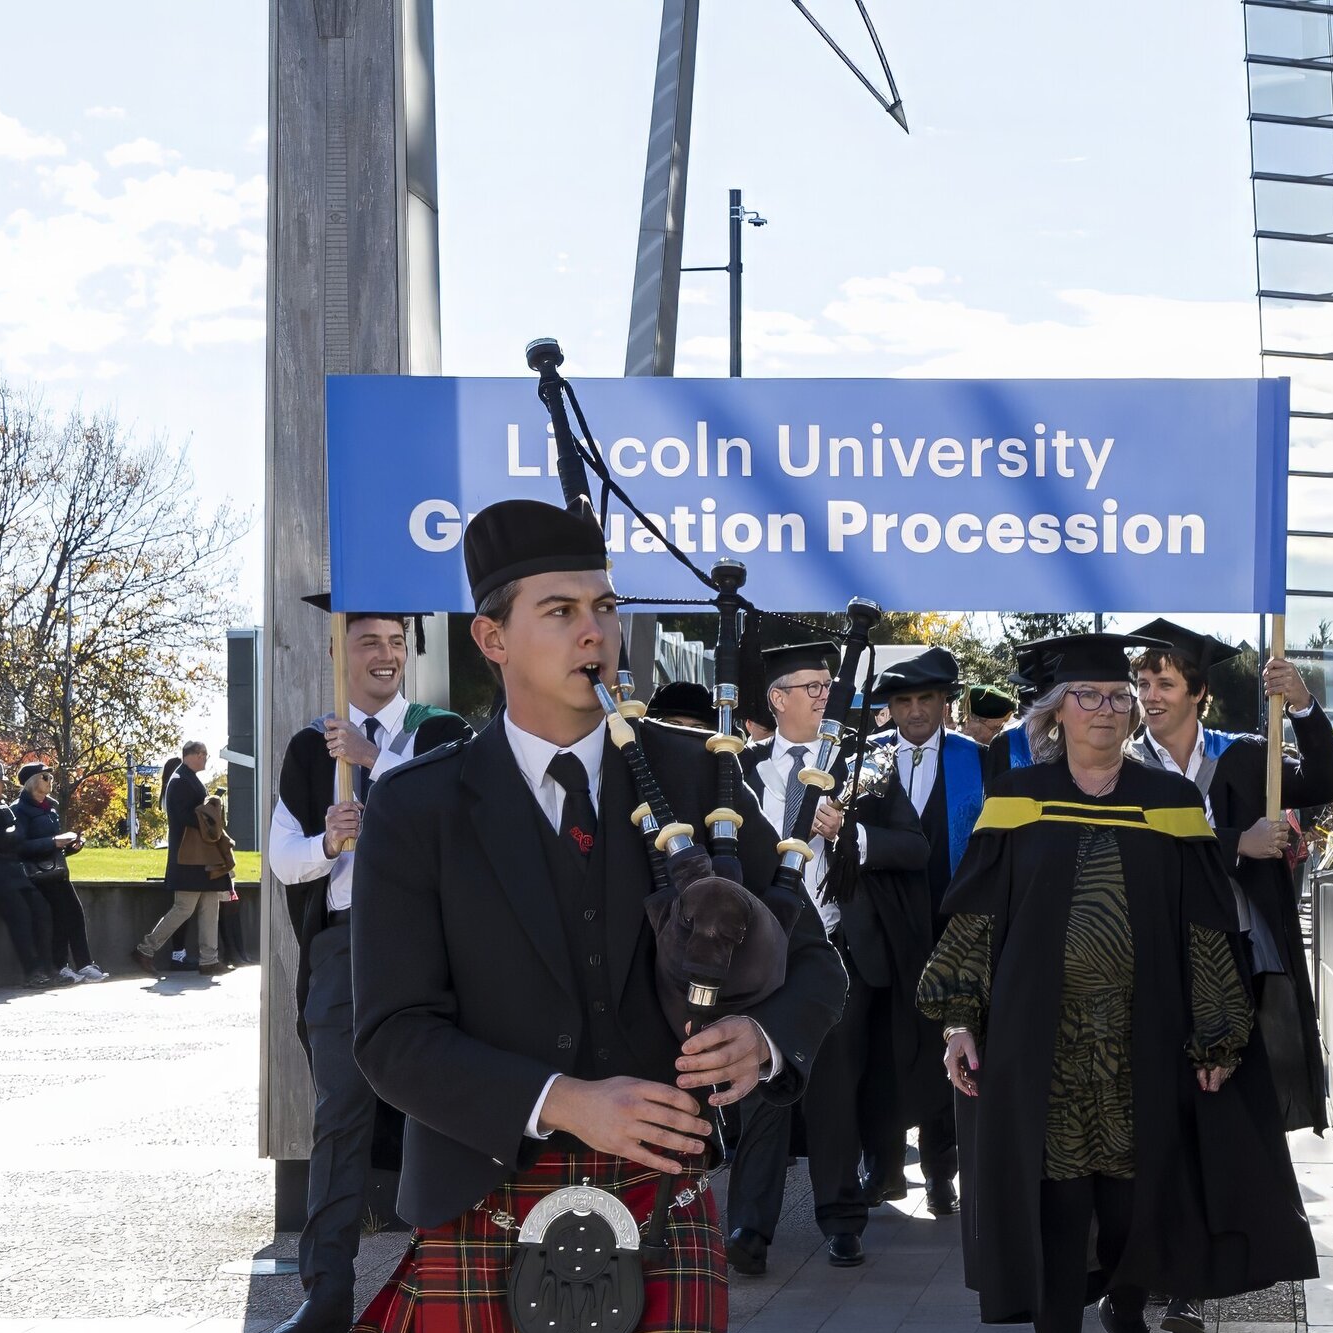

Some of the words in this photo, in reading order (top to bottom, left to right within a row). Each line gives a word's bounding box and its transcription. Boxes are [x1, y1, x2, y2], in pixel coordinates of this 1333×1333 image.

[778, 422, 1115, 490] University
[409, 498, 805, 554] Gation
[827, 498, 1205, 554] Procession
